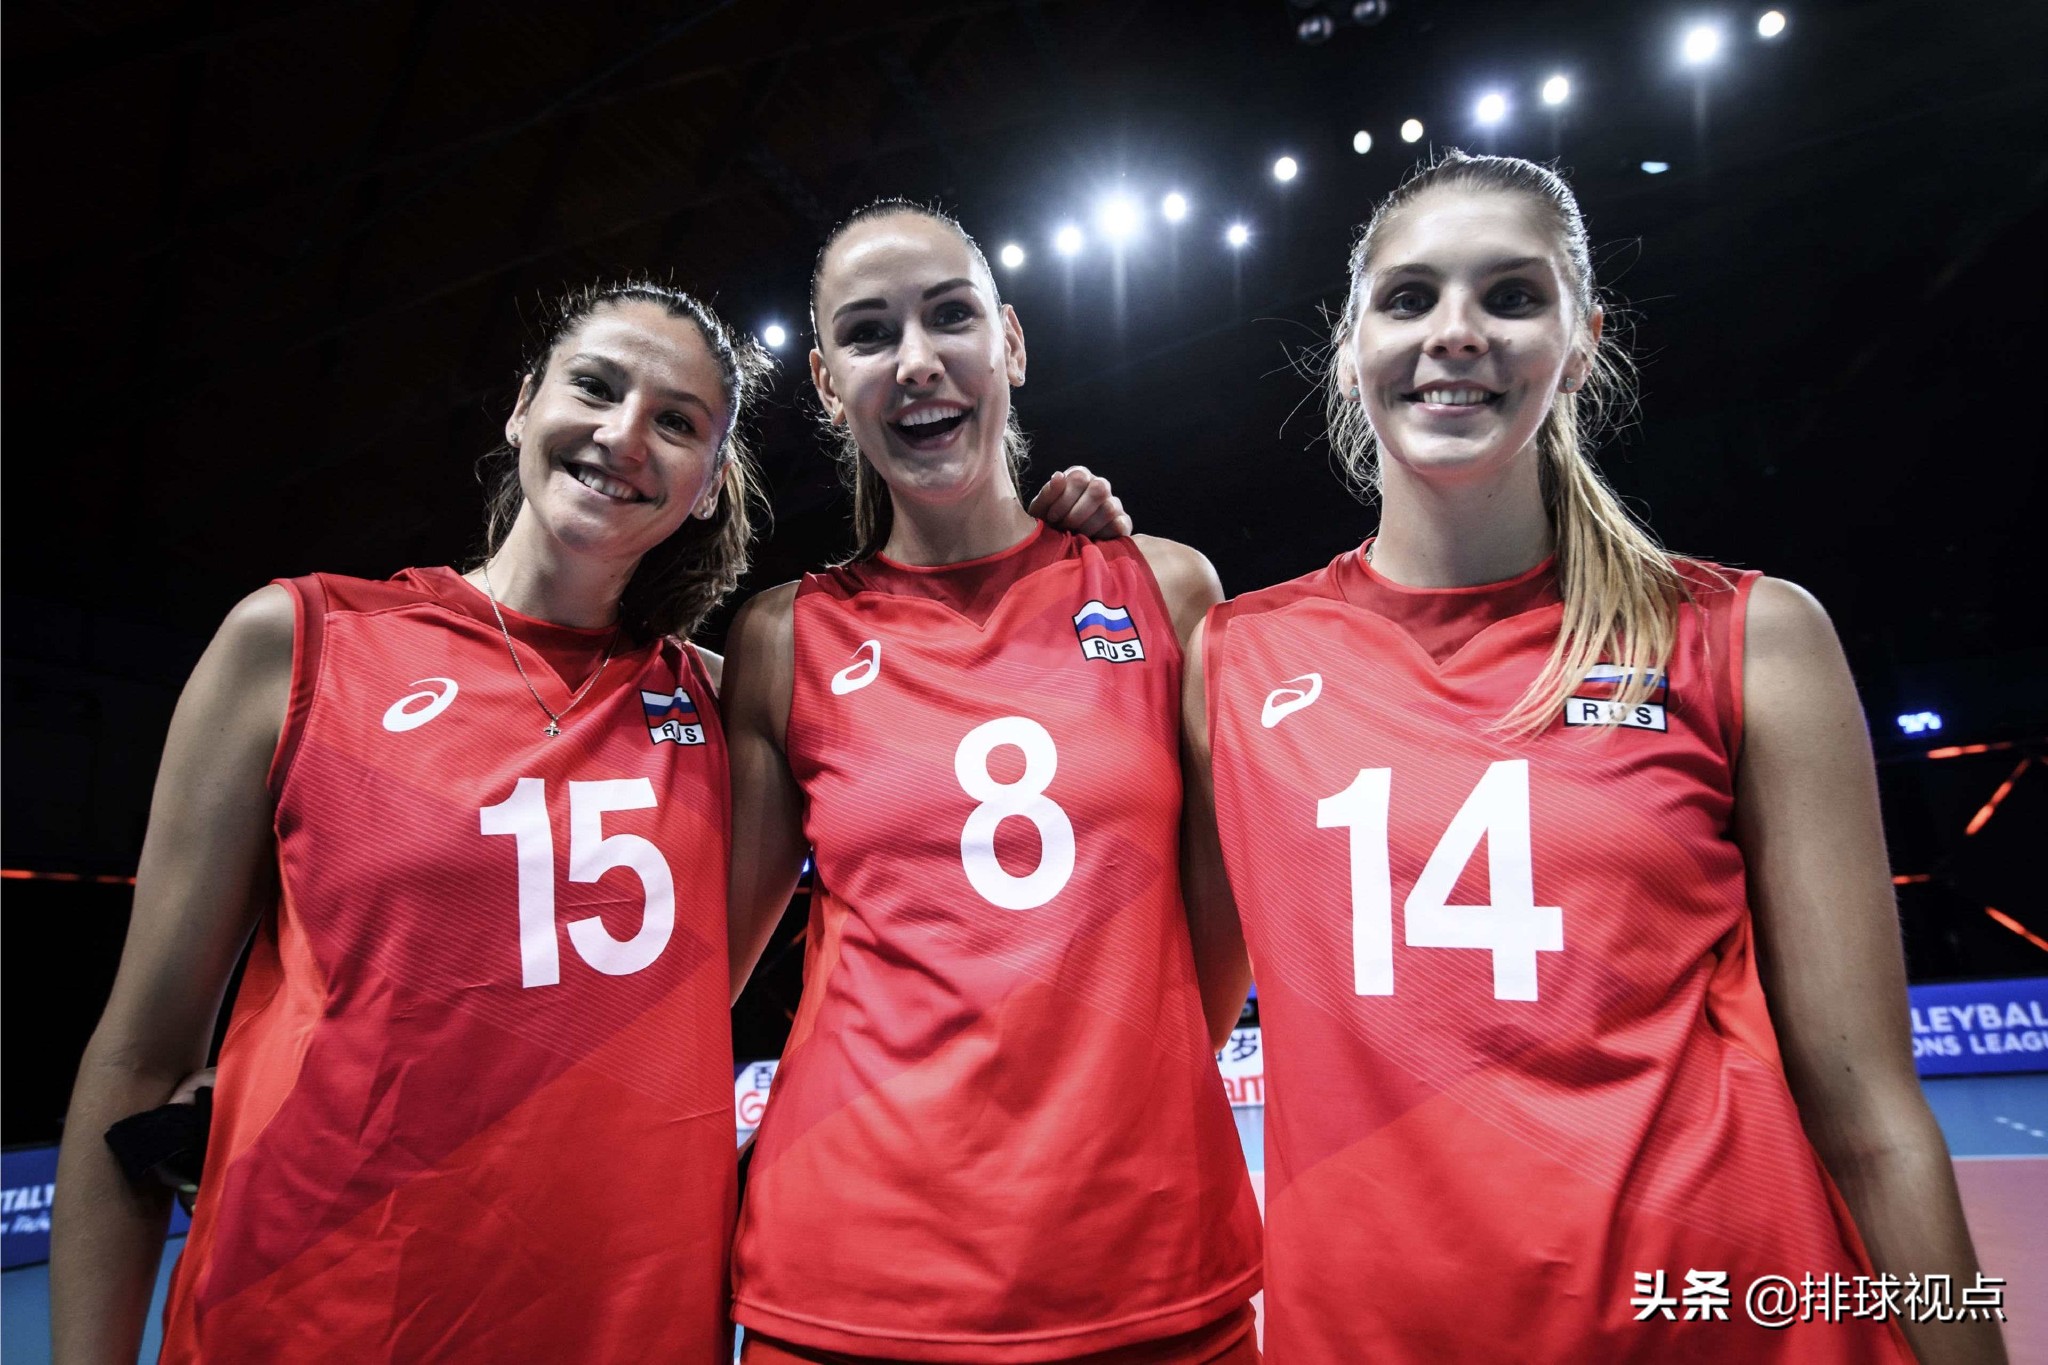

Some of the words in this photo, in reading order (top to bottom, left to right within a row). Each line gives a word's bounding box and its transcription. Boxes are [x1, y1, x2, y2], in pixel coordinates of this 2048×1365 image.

[1093, 640, 1137, 660] RUS
[479, 776, 676, 989] 15
[954, 716, 1076, 911] 8
[1316, 758, 1564, 1002] 14
